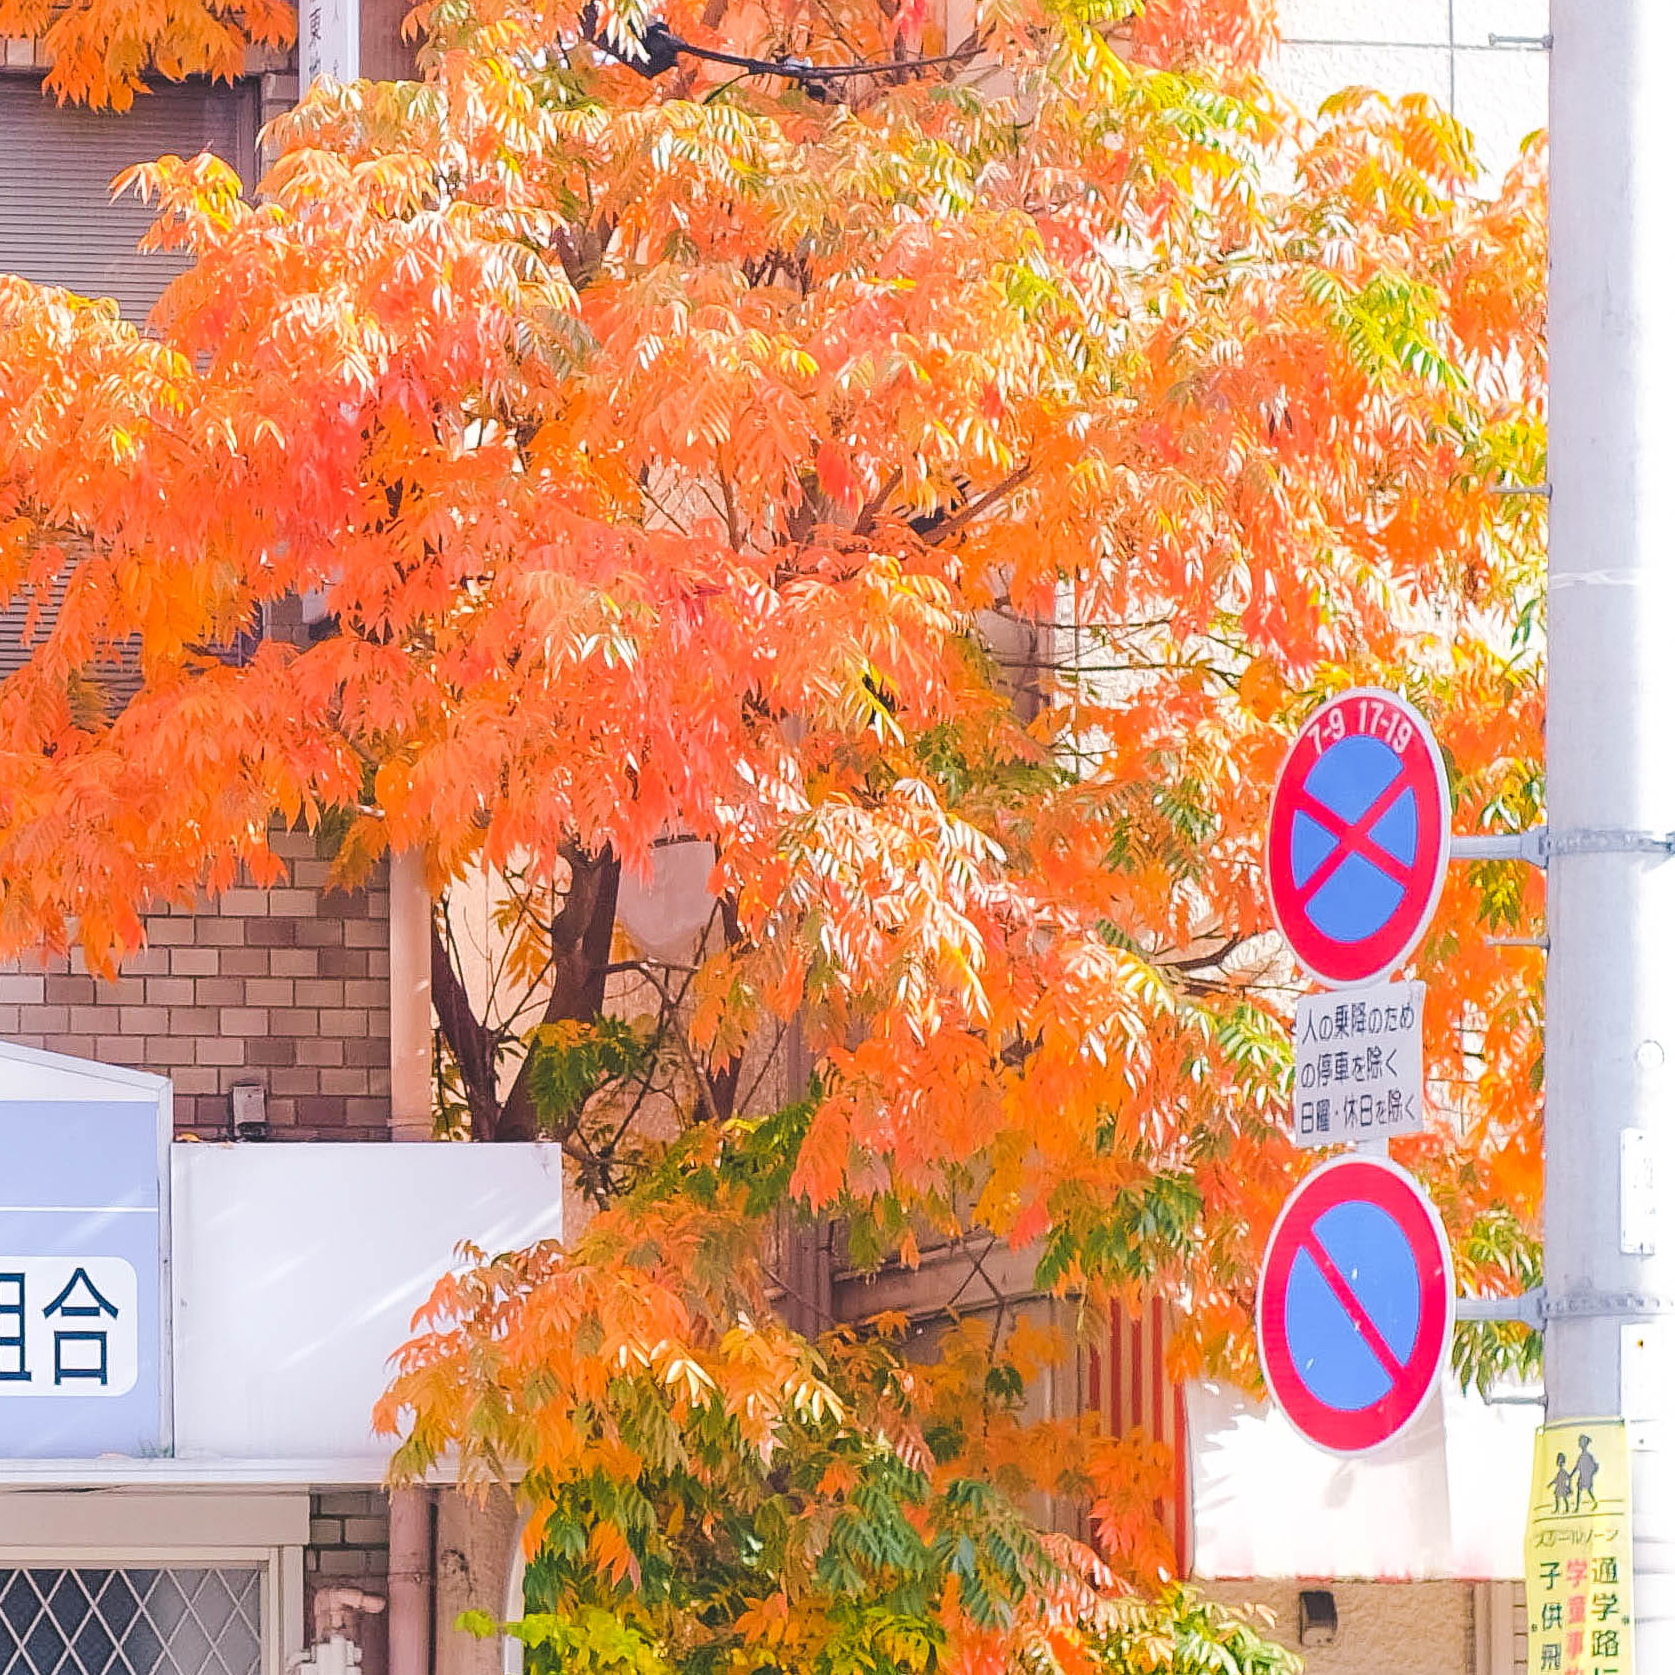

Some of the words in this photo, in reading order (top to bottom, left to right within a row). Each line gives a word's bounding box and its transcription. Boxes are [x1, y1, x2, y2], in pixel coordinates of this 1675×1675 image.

[1306, 706, 1346, 756] 7-9
[1357, 699, 1413, 754] 17-19
[1301, 1001, 1416, 1045] 人の乗降のため
[1300, 1045, 1398, 1088] の停車を除く
[1300, 1086, 1416, 1135] 日曜・休日を除く
